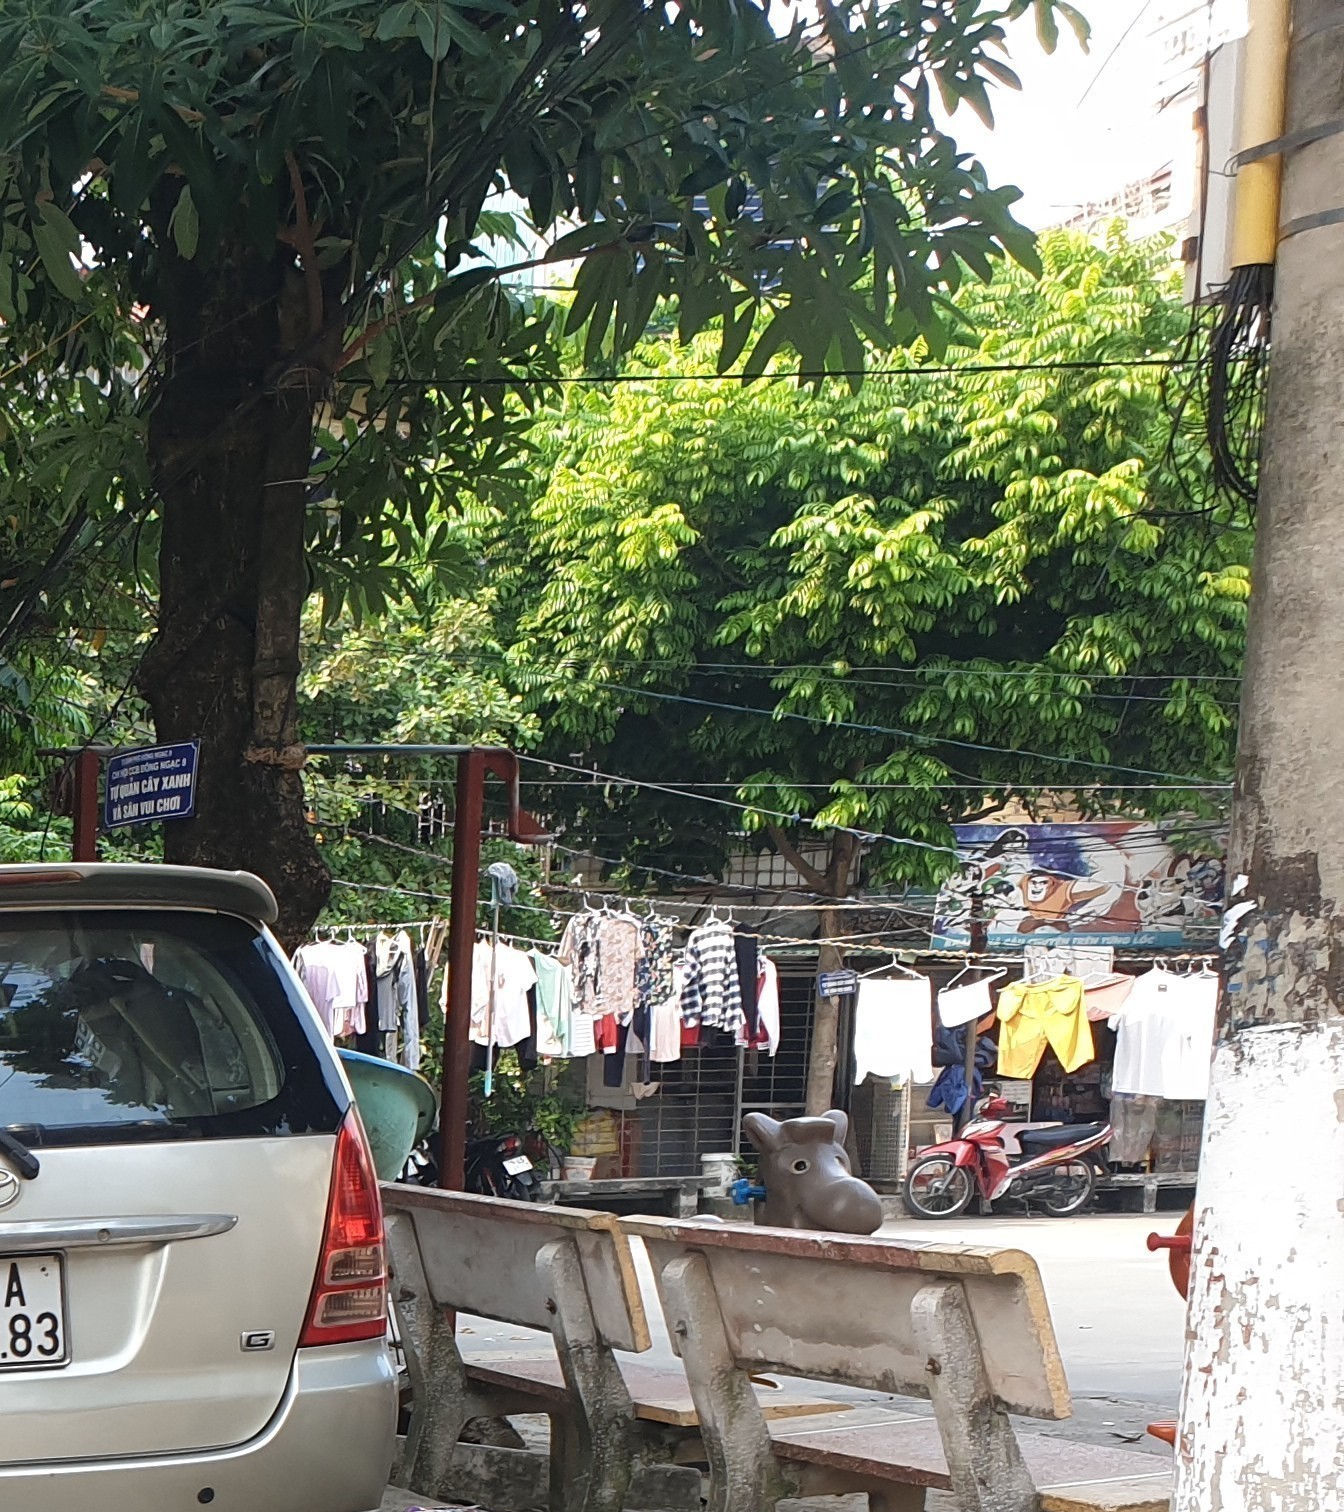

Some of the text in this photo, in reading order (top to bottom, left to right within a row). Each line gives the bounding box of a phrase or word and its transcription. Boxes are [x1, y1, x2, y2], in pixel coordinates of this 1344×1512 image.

[160, 759, 181, 770] NGẠC
[110, 773, 191, 802] TỰ QUẢN CÂY XANH
[112, 795, 181, 821] VÀ SÂN VUI CHƠI
[244, 1332, 271, 1348] G
